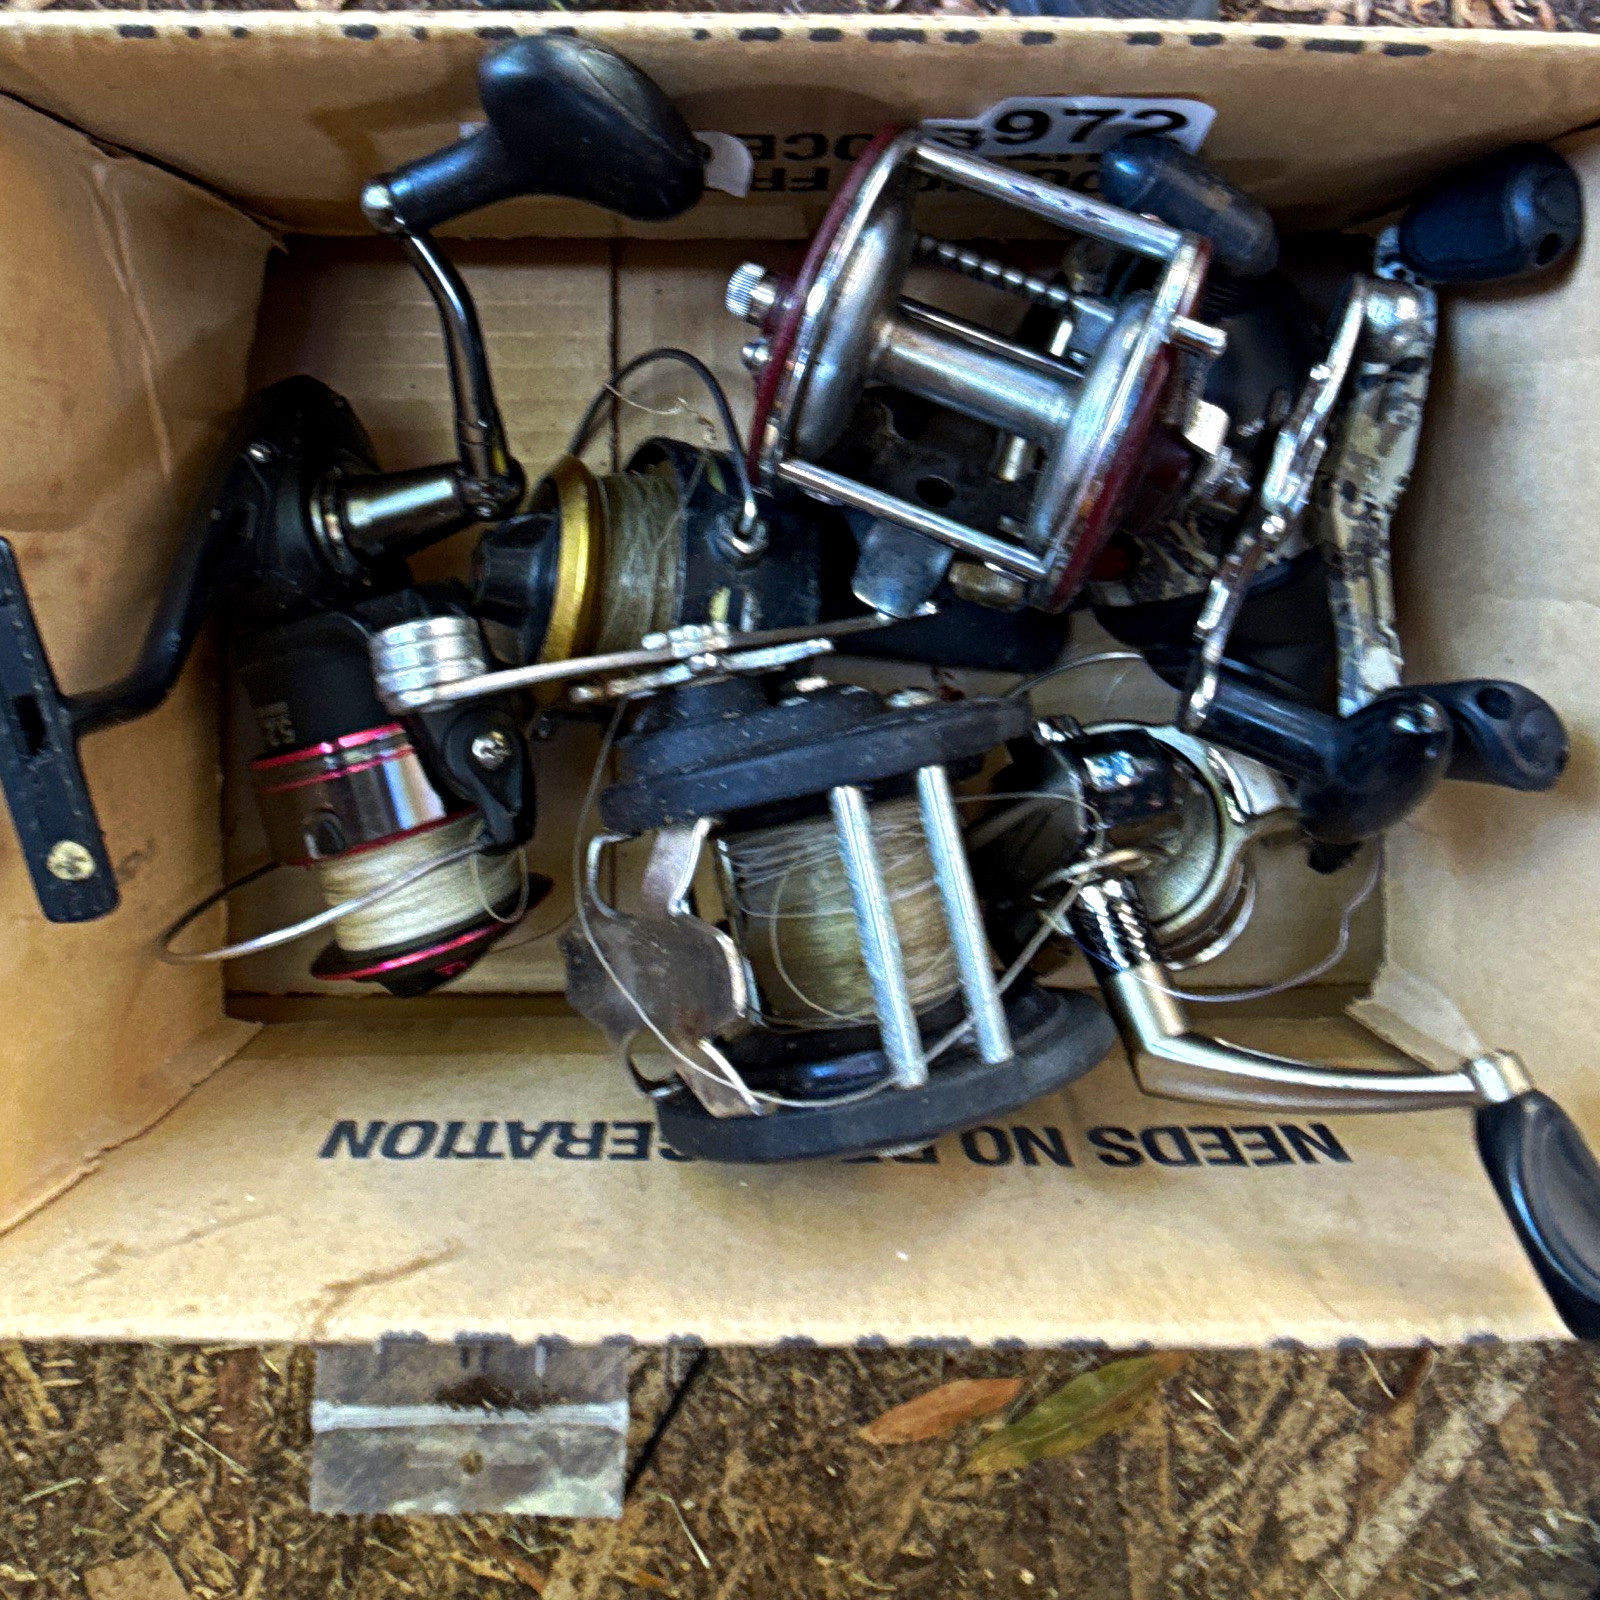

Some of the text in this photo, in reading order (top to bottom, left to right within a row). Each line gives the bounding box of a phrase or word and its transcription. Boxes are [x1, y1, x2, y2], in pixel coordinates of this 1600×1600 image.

[319, 1117, 1354, 1168] NEEDS NO ERATION
